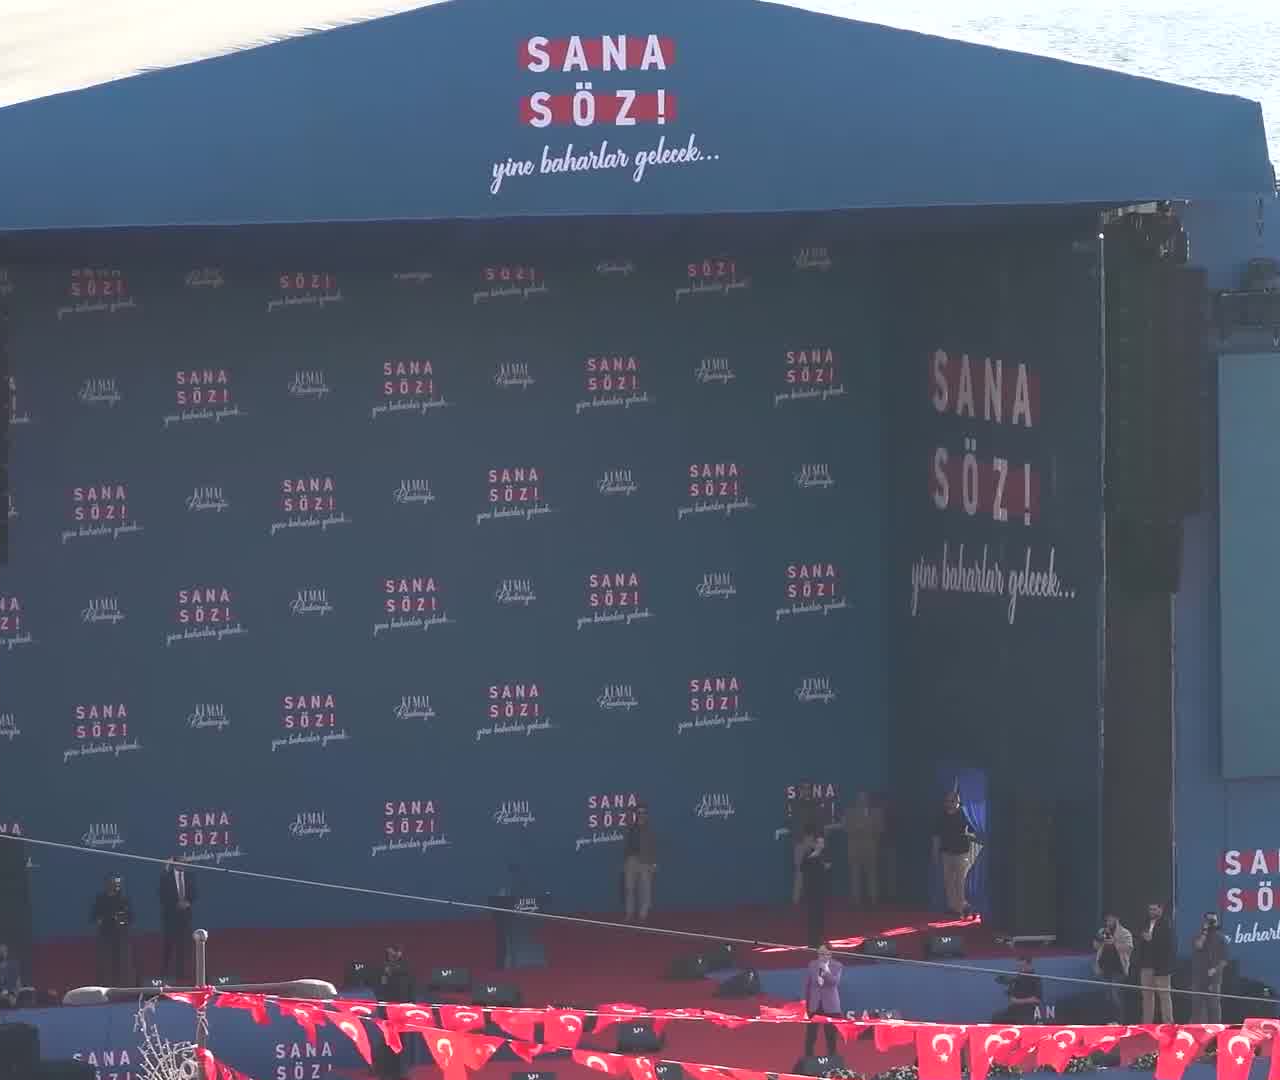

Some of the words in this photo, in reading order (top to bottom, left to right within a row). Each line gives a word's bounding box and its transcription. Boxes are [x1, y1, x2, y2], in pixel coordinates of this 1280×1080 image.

[527, 34, 666, 73] SANA
[529, 82, 666, 128] SÖZ!
[490, 158, 534, 194] yine
[540, 140, 628, 175] baharlar
[635, 133, 720, 183] gelecek...
[587, 357, 637, 372] SANA
[786, 349, 833, 365] SANA
[384, 361, 433, 376] SANA
[787, 366, 833, 383] SÖZ!
[177, 370, 228, 385] SANA
[385, 377, 433, 394] SÖZ!
[588, 374, 637, 390] SÖZ!
[177, 387, 230, 404] SÖZ!
[932, 348, 1032, 427] SANA
[488, 468, 538, 483] SANA
[689, 464, 738, 478] SANA
[283, 477, 333, 493] SANA
[690, 480, 738, 496] SÖZ!
[933, 437, 1032, 526] SÖZ!
[73, 485, 126, 502] SANA
[489, 485, 538, 502] SÖZ!
[284, 493, 333, 511] SÖZ!
[74, 502, 126, 520] SÖZ!
[787, 565, 834, 579] SANA
[942, 540, 1004, 596] baharlar
[385, 578, 436, 593] SANA
[589, 573, 638, 588] SANA
[178, 588, 231, 604] SANA
[788, 581, 834, 598] SÖZ!
[386, 595, 436, 612] SÖZ!
[590, 590, 638, 606] SÖZ!
[179, 605, 231, 623] SÖZ!
[0, 616, 20, 630] Z!
[489, 685, 538, 698] SANA
[690, 677, 740, 692] SANA
[284, 695, 335, 709] SANA
[490, 701, 538, 717] SÖZ!
[691, 694, 738, 711] SÖZ!
[76, 704, 128, 720] SANA
[285, 711, 335, 728] SÖZ!
[77, 720, 128, 738] SÖZ!
[787, 784, 834, 799] SNA
[385, 800, 435, 816] SANA
[588, 795, 637, 809] SANA
[178, 811, 230, 827] SANA
[385, 817, 435, 834] SÖZ!
[179, 828, 230, 846] SÖZ!
[276, 1042, 333, 1058] SANA
